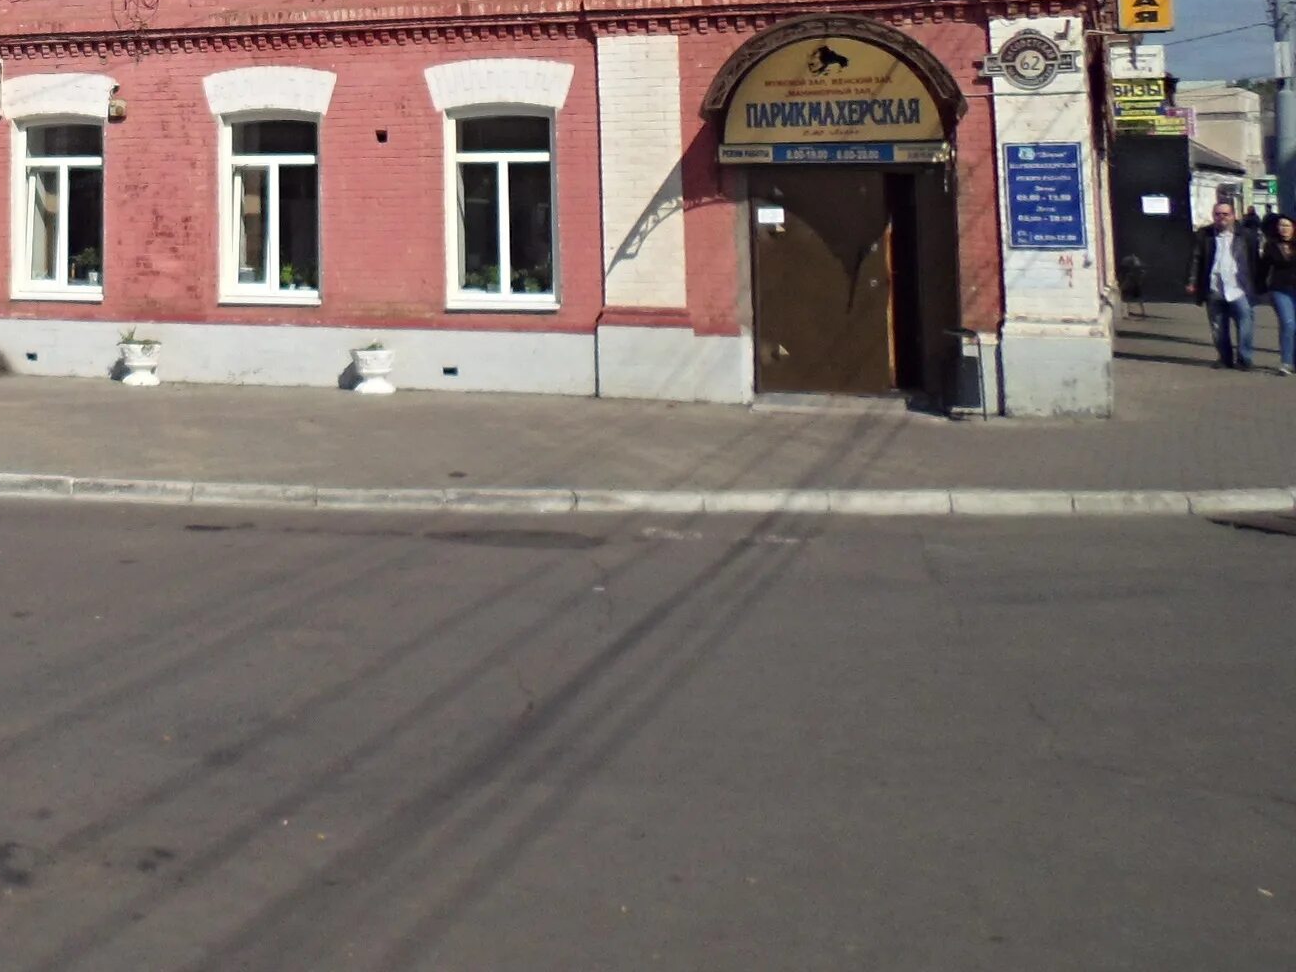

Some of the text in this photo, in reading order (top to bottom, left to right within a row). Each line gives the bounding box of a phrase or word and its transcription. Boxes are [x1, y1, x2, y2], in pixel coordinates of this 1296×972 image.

[1019, 55, 1041, 71] 62
[1113, 83, 1161, 97] ВИЗЫ
[746, 98, 920, 128] ПАРИКМАХЕРСКАЯ
